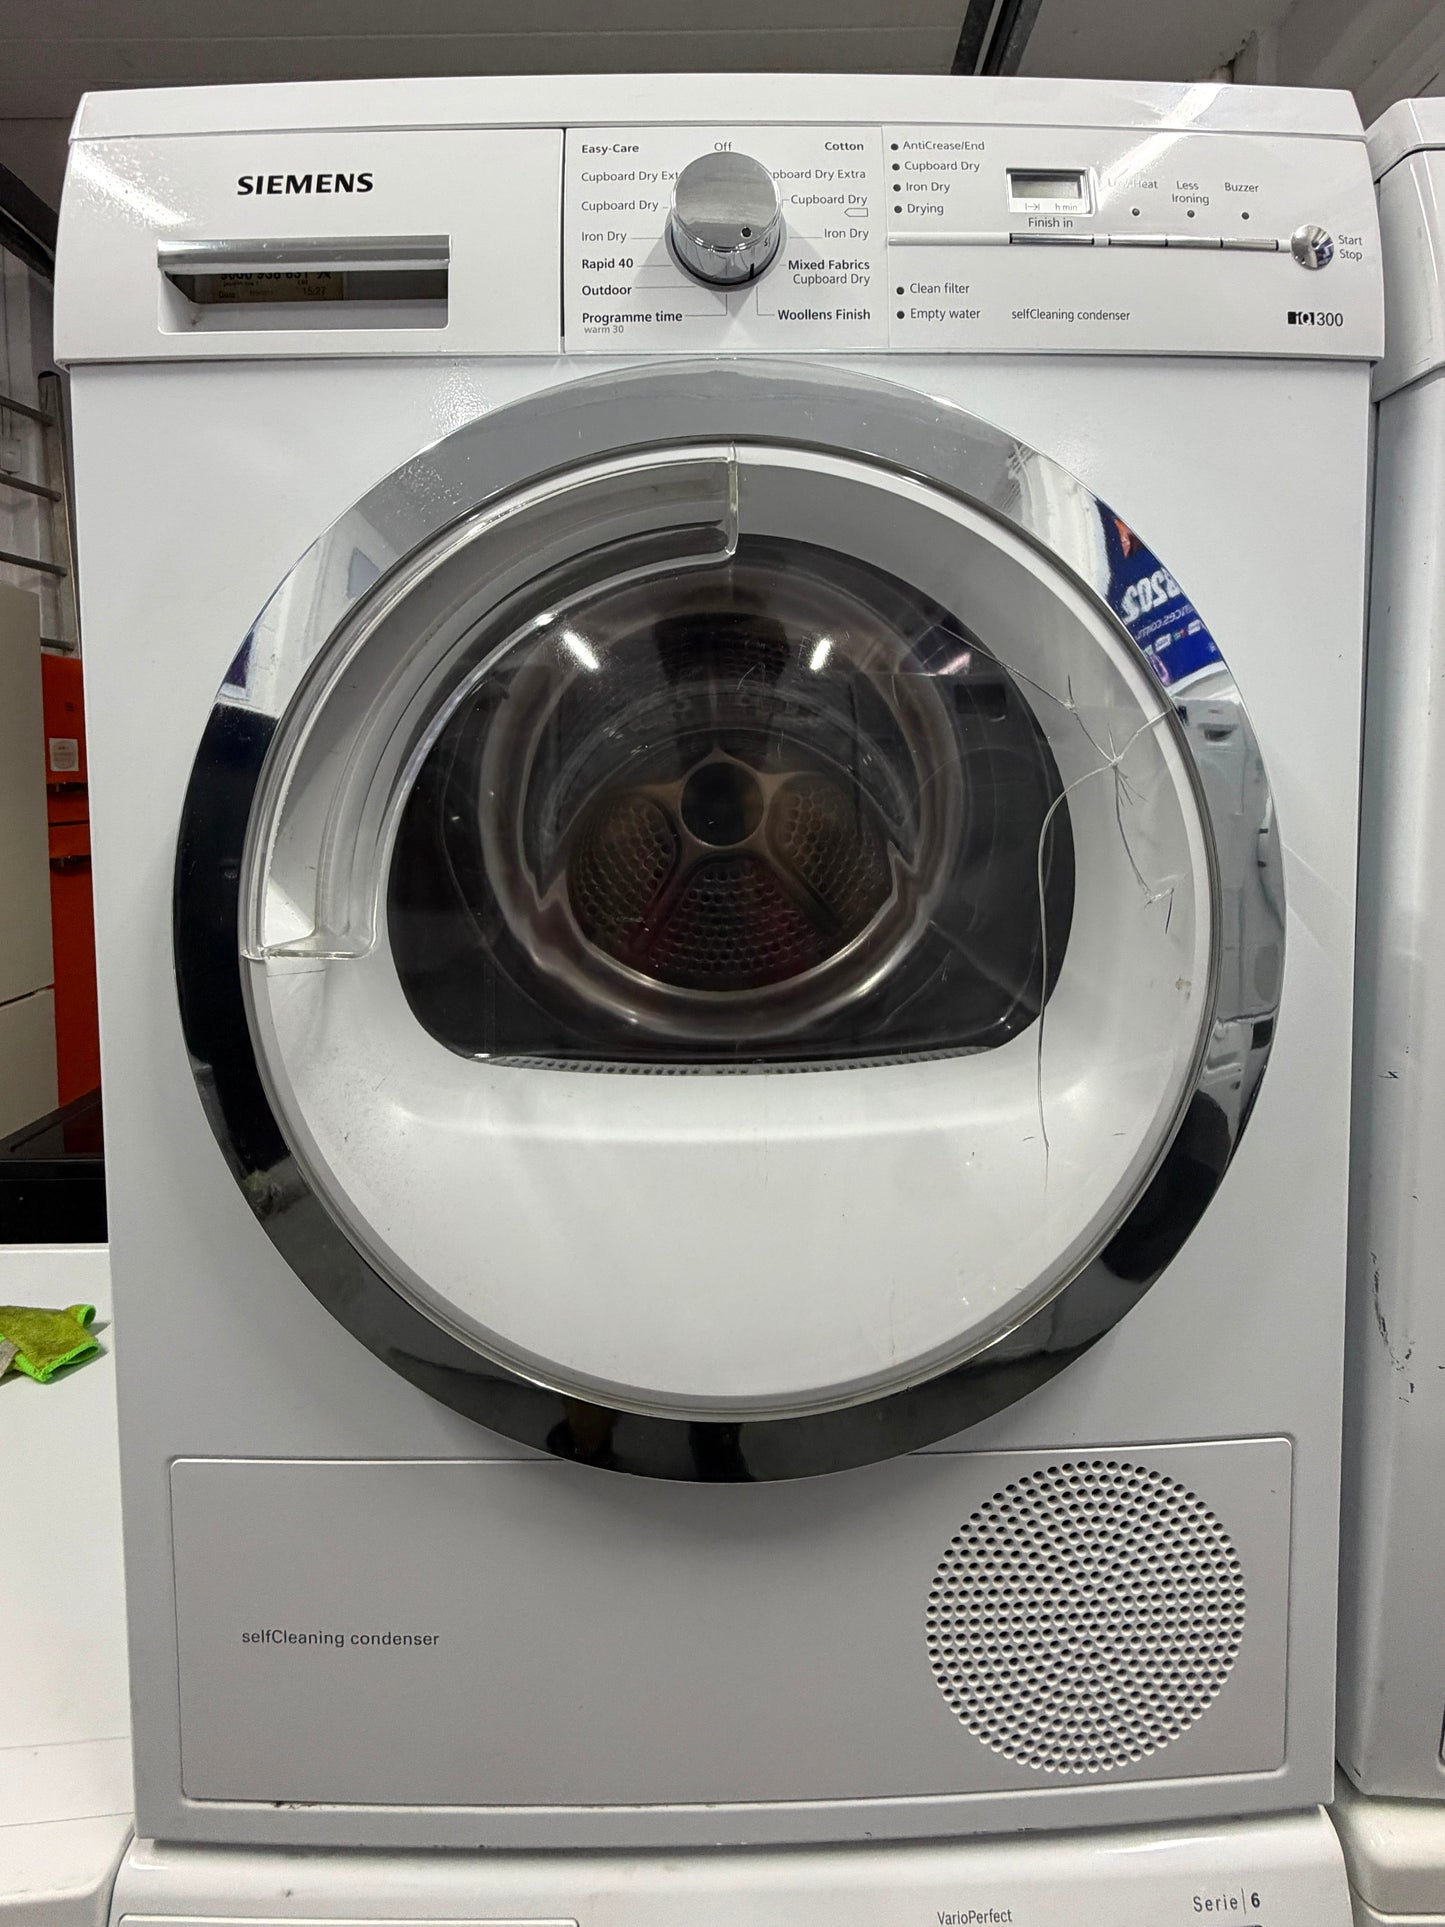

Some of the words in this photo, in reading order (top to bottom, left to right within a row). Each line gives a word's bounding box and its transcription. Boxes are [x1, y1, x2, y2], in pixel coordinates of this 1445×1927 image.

[581, 143, 640, 154] Easy-Care
[714, 142, 732, 152] Off
[824, 141, 864, 152] Cotton
[902, 140, 985, 151] AntiCrease/End
[904, 160, 957, 173] Cupboard
[961, 161, 980, 173] Dry
[581, 171, 636, 184] Cupboard
[639, 170, 658, 183] Dry
[661, 170, 679, 181] Ext
[770, 169, 812, 180] pboard
[815, 169, 835, 181] Dry
[838, 169, 866, 179] Extra
[237, 173, 374, 195] SIEMENS
[905, 182, 928, 192] Iron
[931, 182, 951, 195] Dry
[1134, 179, 1159, 189] Heat
[1176, 180, 1199, 191] Less
[1224, 182, 1260, 193] Buzzer
[790, 194, 845, 207] Cupboard
[849, 194, 868, 206] Dry
[1172, 193, 1210, 206] Ironing
[581, 200, 637, 214] Cupboard
[640, 200, 659, 214] Dry
[907, 203, 944, 216] Drying
[1028, 217, 1060, 228] Finish
[1063, 217, 1073, 228] in
[581, 231, 604, 242] Iron
[607, 230, 627, 244] Dry
[824, 228, 847, 239] Iron
[851, 228, 869, 241] Dry
[1338, 234, 1363, 246] Start
[1339, 249, 1363, 262] Stop
[581, 258, 615, 272] Rapid
[618, 258, 634, 269] 40
[788, 260, 825, 271] Mixed
[829, 259, 870, 271] Fabrics
[793, 274, 848, 287] Cupboard
[851, 273, 870, 287] Dry
[581, 285, 632, 295] Outdoor
[909, 283, 941, 294] Clean
[944, 282, 970, 294] filter
[581, 312, 652, 326] Programme
[656, 311, 683, 322] time
[778, 309, 831, 321] Woollens
[835, 309, 871, 321] Finish
[910, 308, 946, 321] Empty
[949, 309, 981, 320] water
[1011, 308, 1075, 322] selfCleaning
[1077, 309, 1131, 321] condenser
[584, 326, 610, 334] warm
[612, 325, 624, 334] 30
[241, 1629, 345, 1648] selfCleaning
[350, 1631, 440, 1646] condenser
[1193, 1895, 1239, 1913] Serie
[937, 1908, 1012, 1926] VarioPerfect
